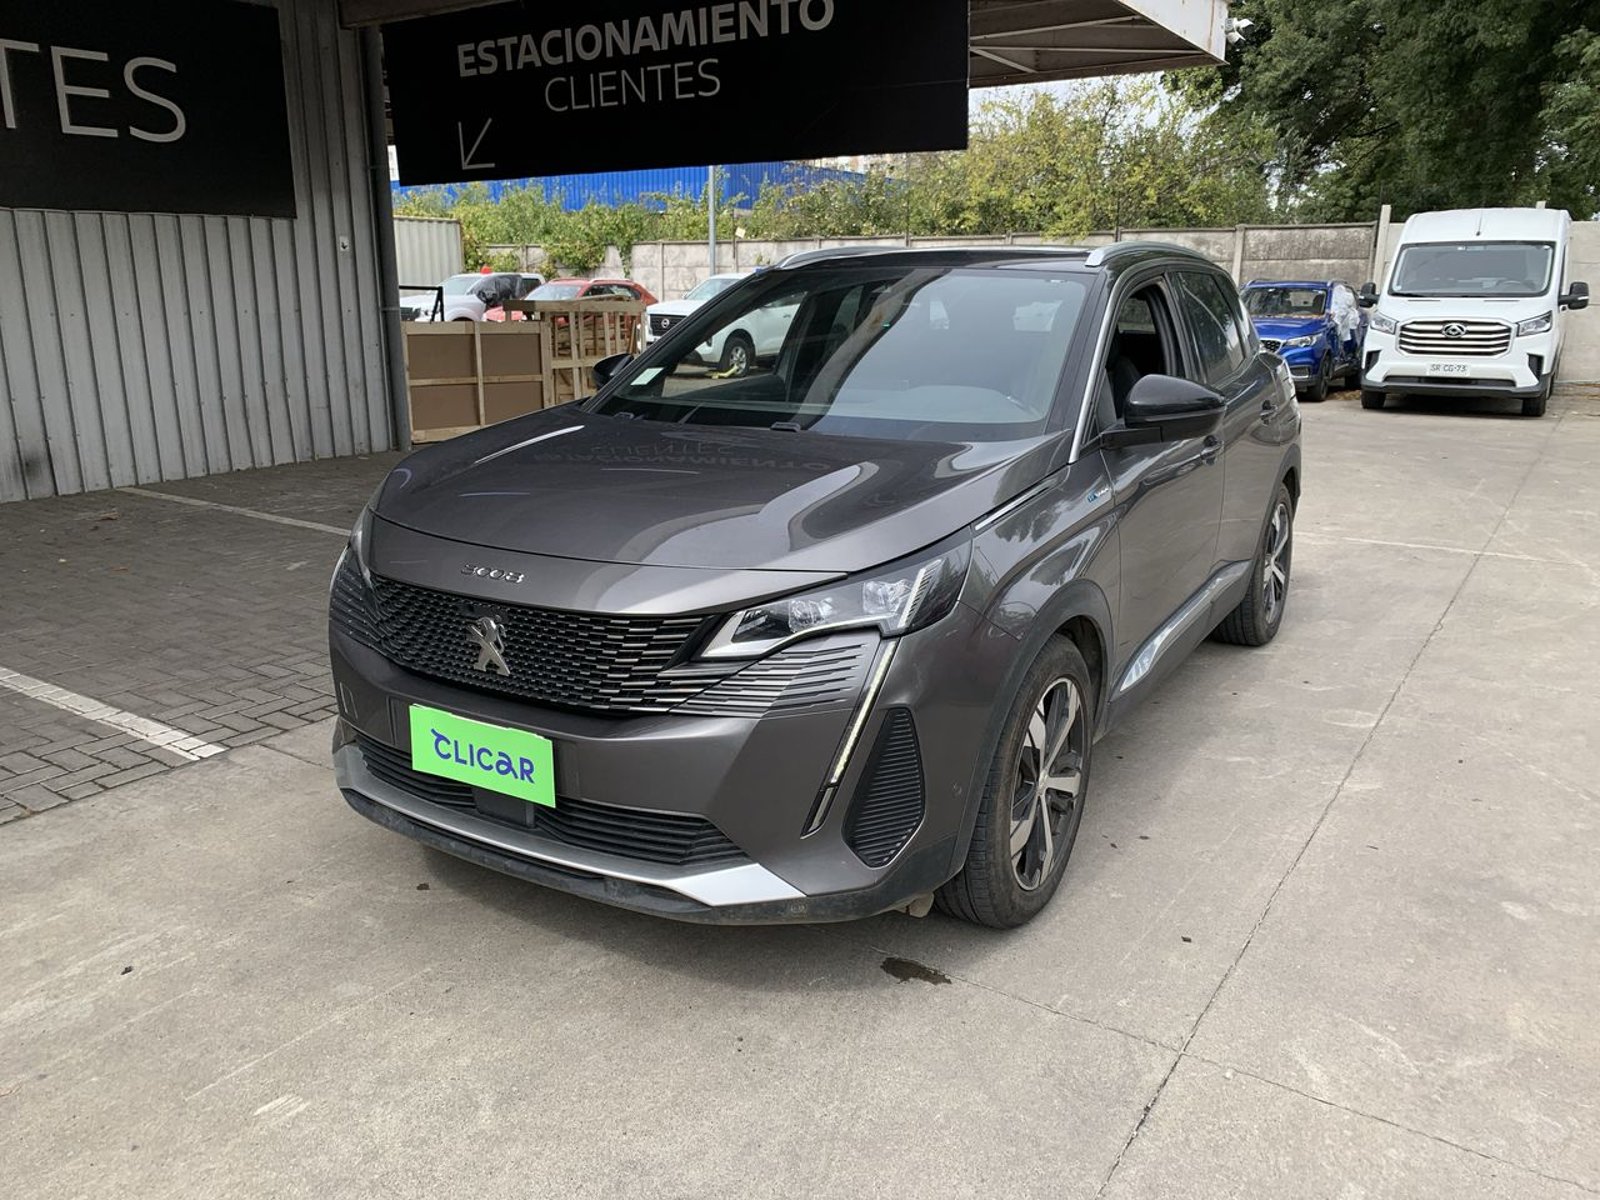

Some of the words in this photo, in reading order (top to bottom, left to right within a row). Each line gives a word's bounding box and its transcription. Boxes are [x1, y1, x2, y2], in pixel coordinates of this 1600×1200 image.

[457, 0, 835, 78] ESTACIONAMIENTO
[545, 58, 722, 113] CLIENTES
[461, 564, 525, 584] 3008
